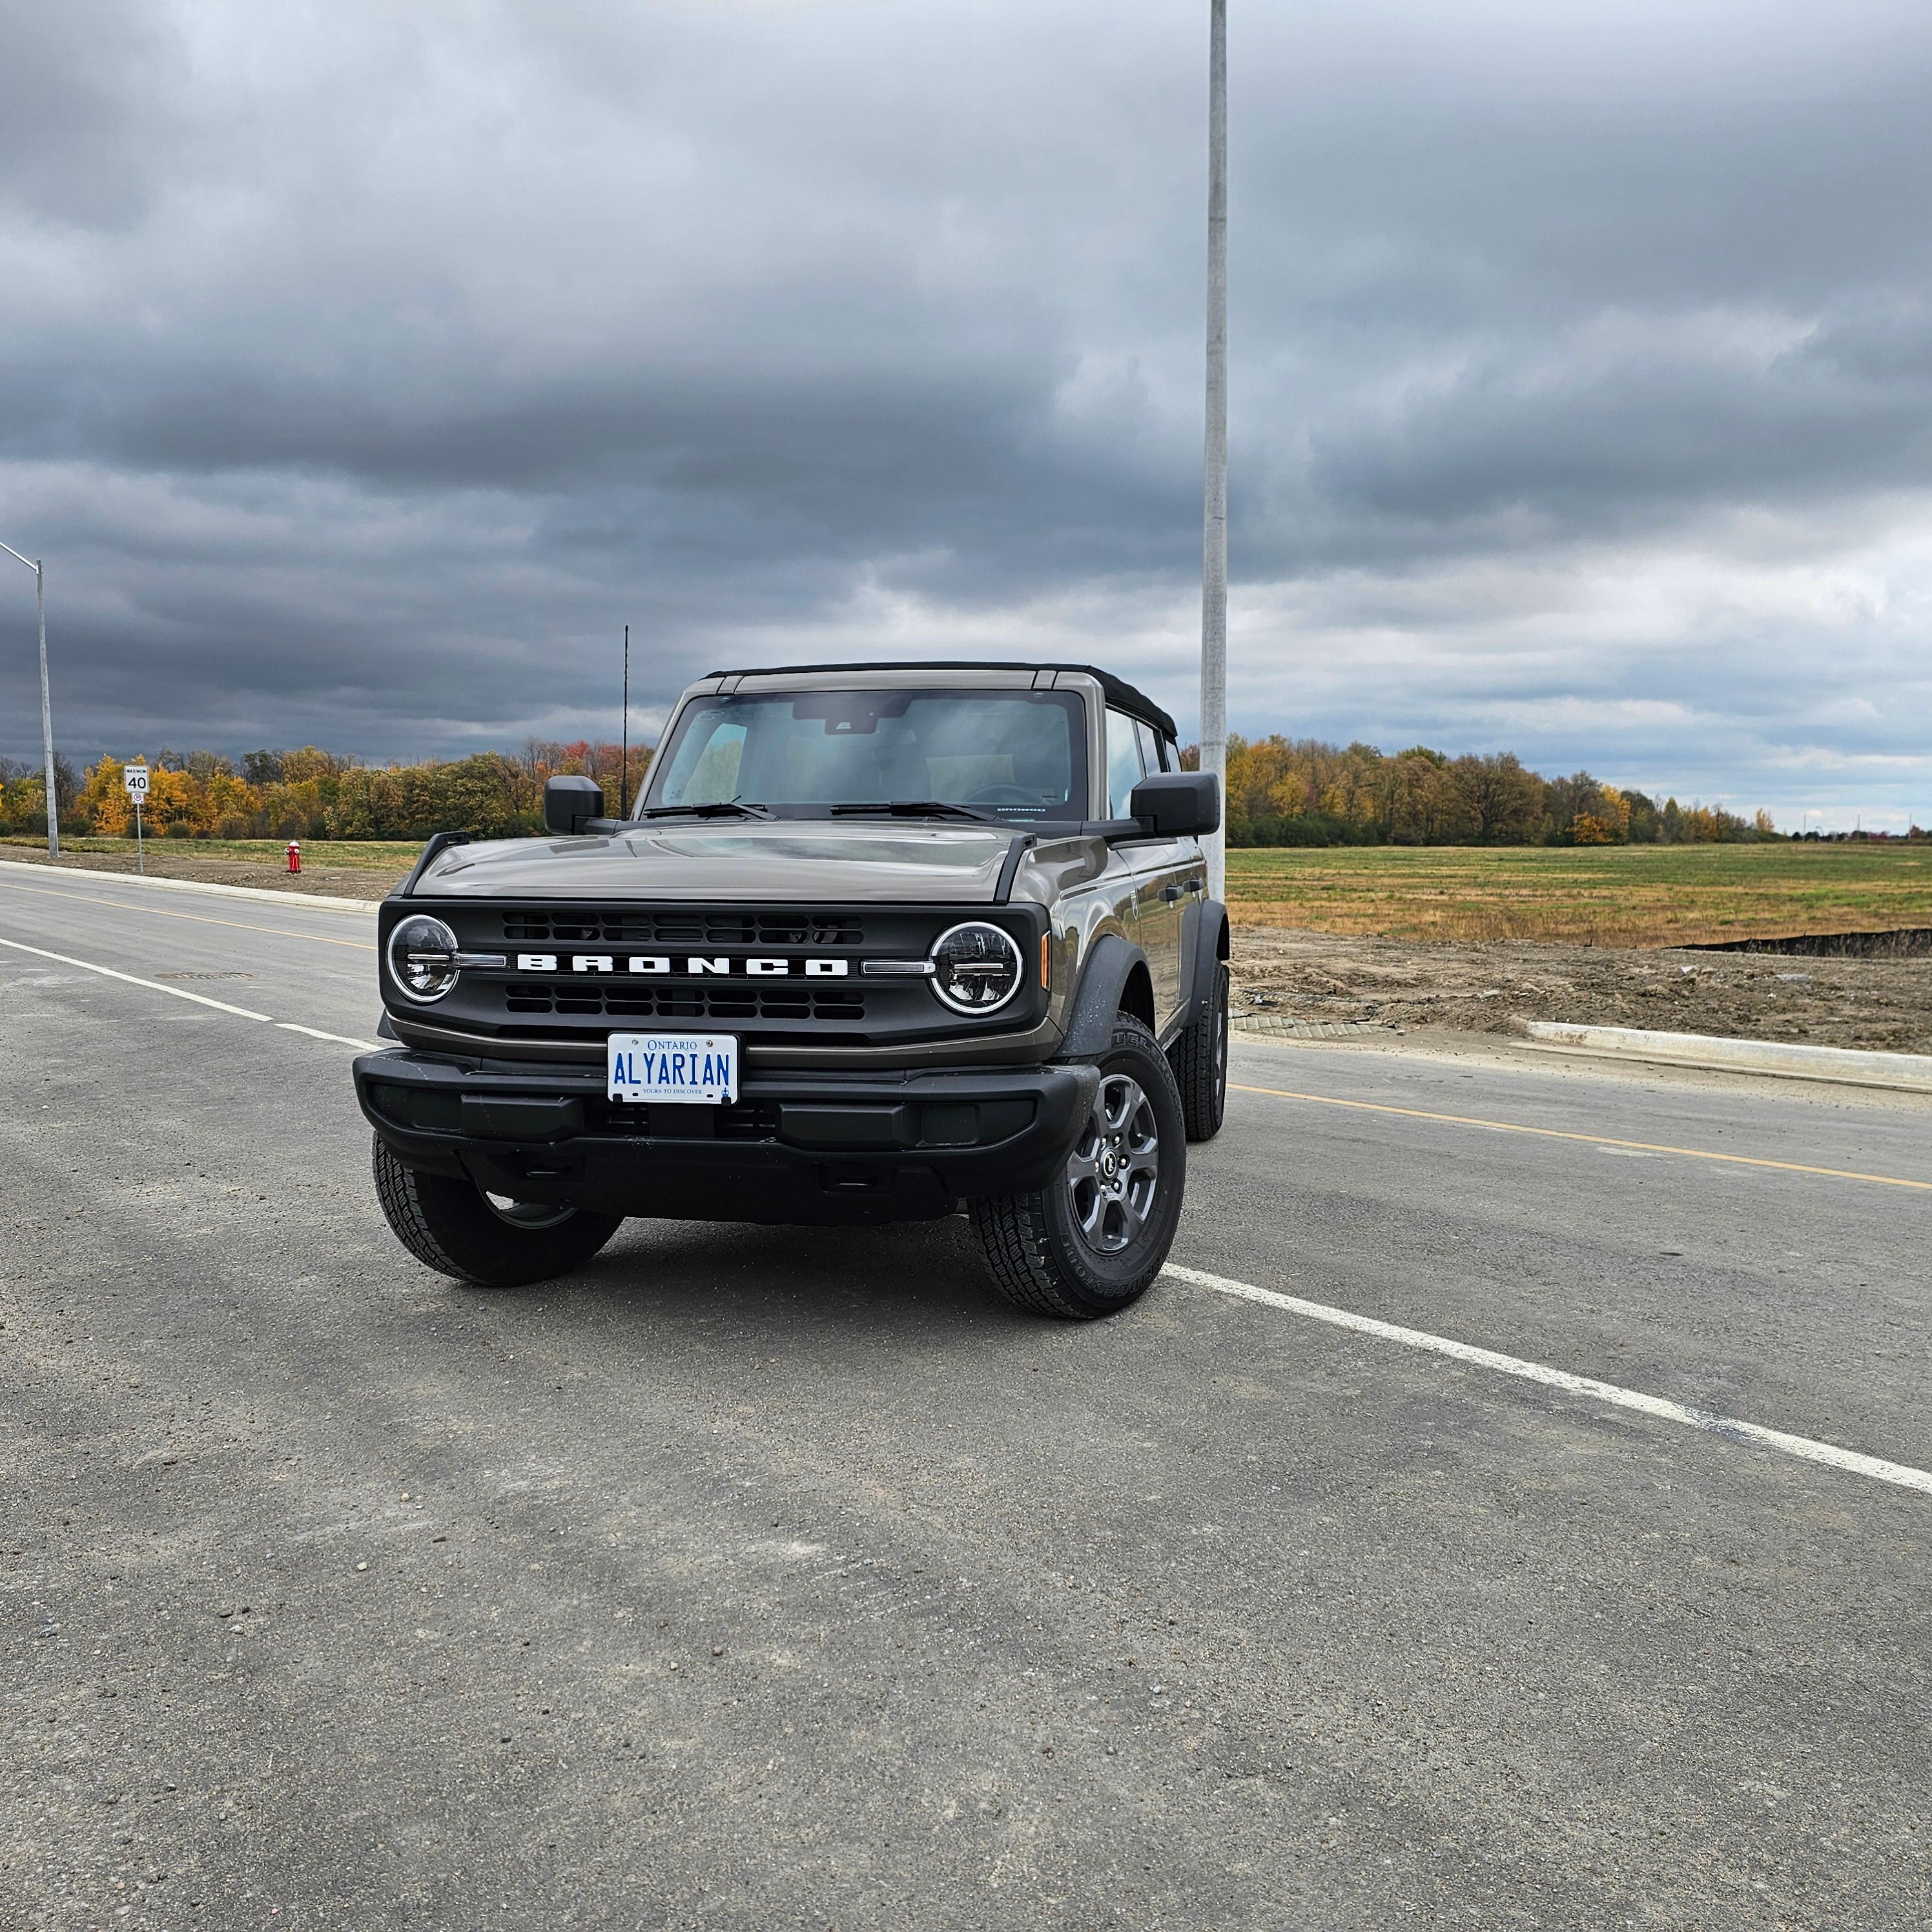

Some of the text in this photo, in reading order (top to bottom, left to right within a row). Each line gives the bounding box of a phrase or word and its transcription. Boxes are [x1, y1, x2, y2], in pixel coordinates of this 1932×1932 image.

[128, 777, 146, 789] 40
[517, 954, 848, 976] BRONCO
[614, 1053, 729, 1085] ALYARIAN
